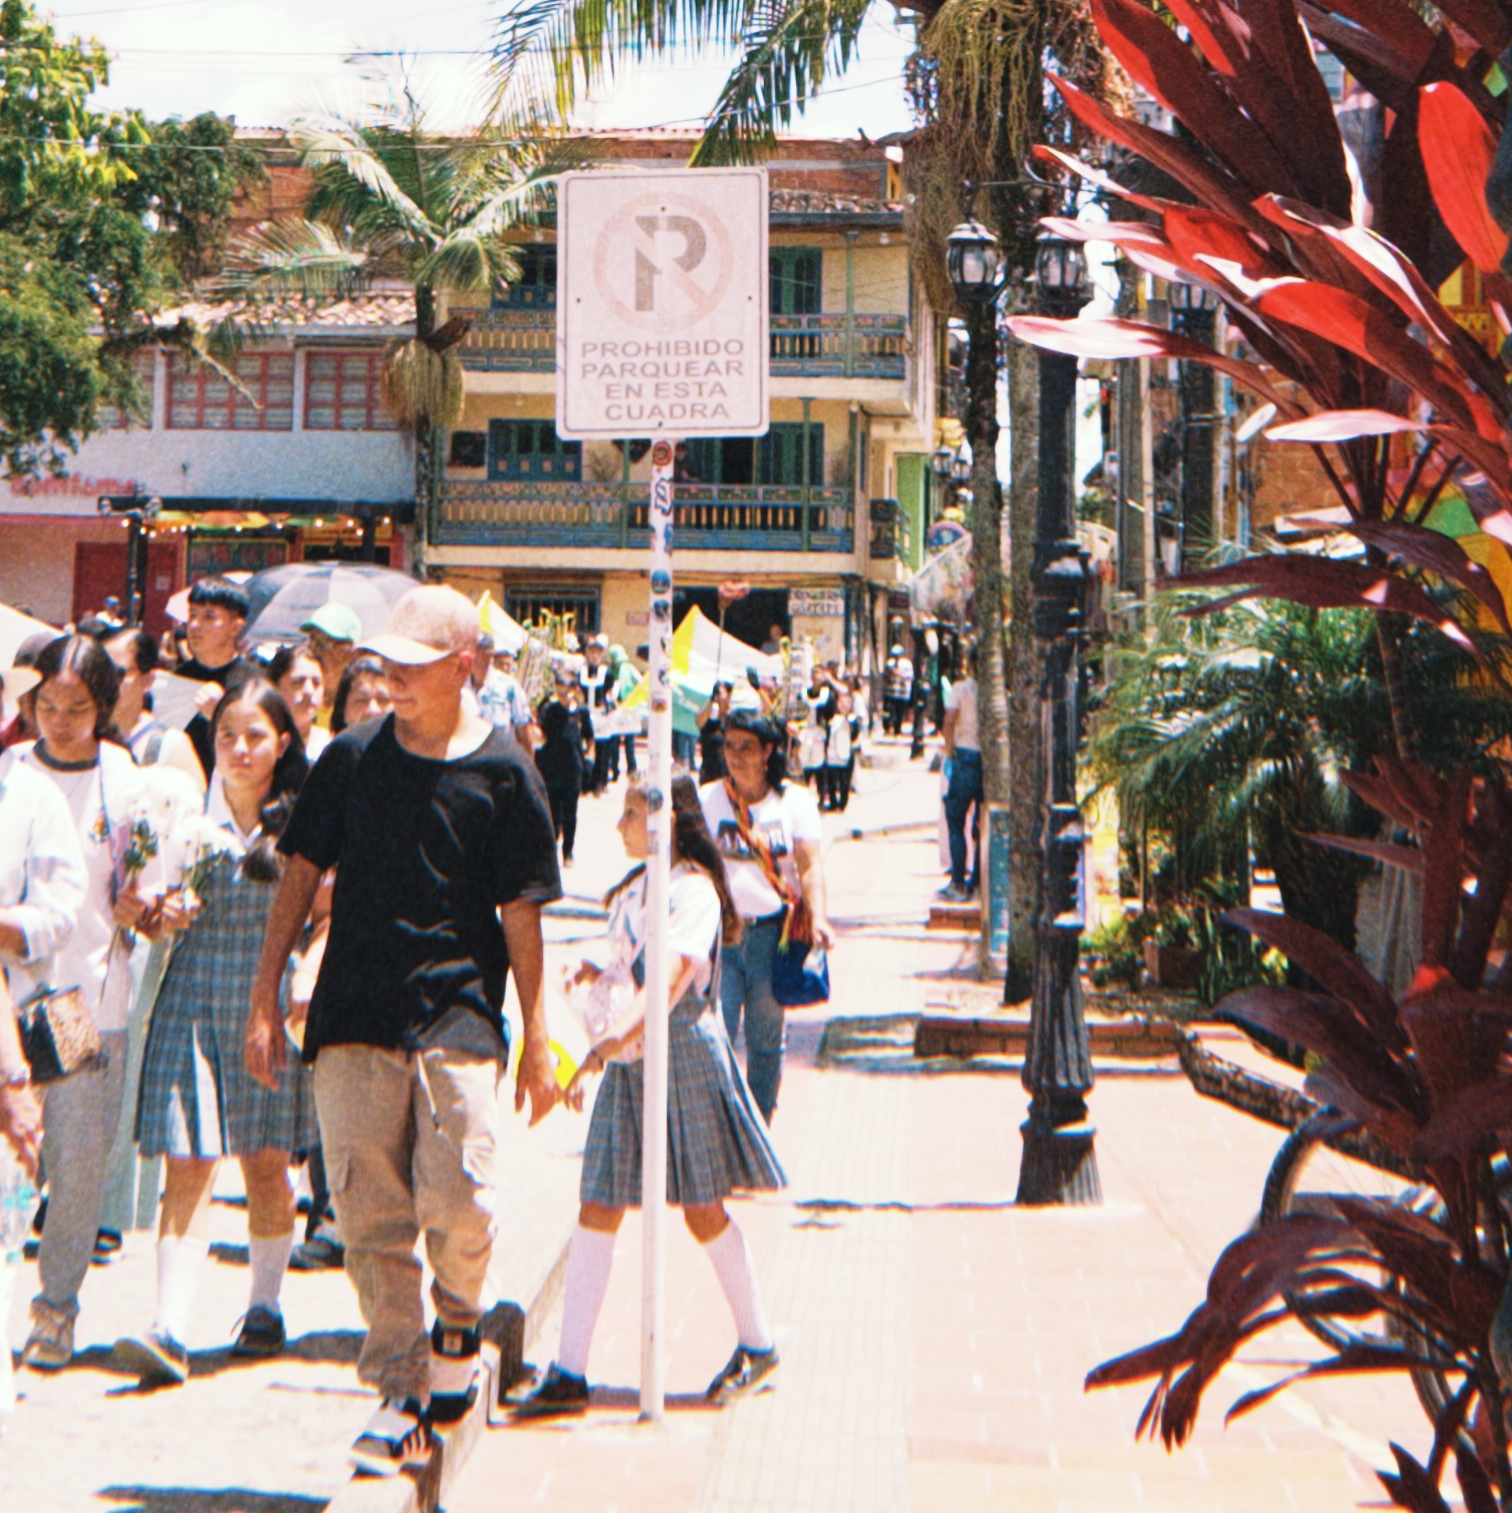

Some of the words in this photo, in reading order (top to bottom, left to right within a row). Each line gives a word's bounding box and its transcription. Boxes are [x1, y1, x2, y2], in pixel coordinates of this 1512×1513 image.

[581, 339, 744, 358] PROHIBIDO
[581, 359, 744, 379] PARQUEAR
[605, 382, 642, 399] EN
[654, 381, 728, 398] ESTA
[605, 402, 730, 421] CUADRA
